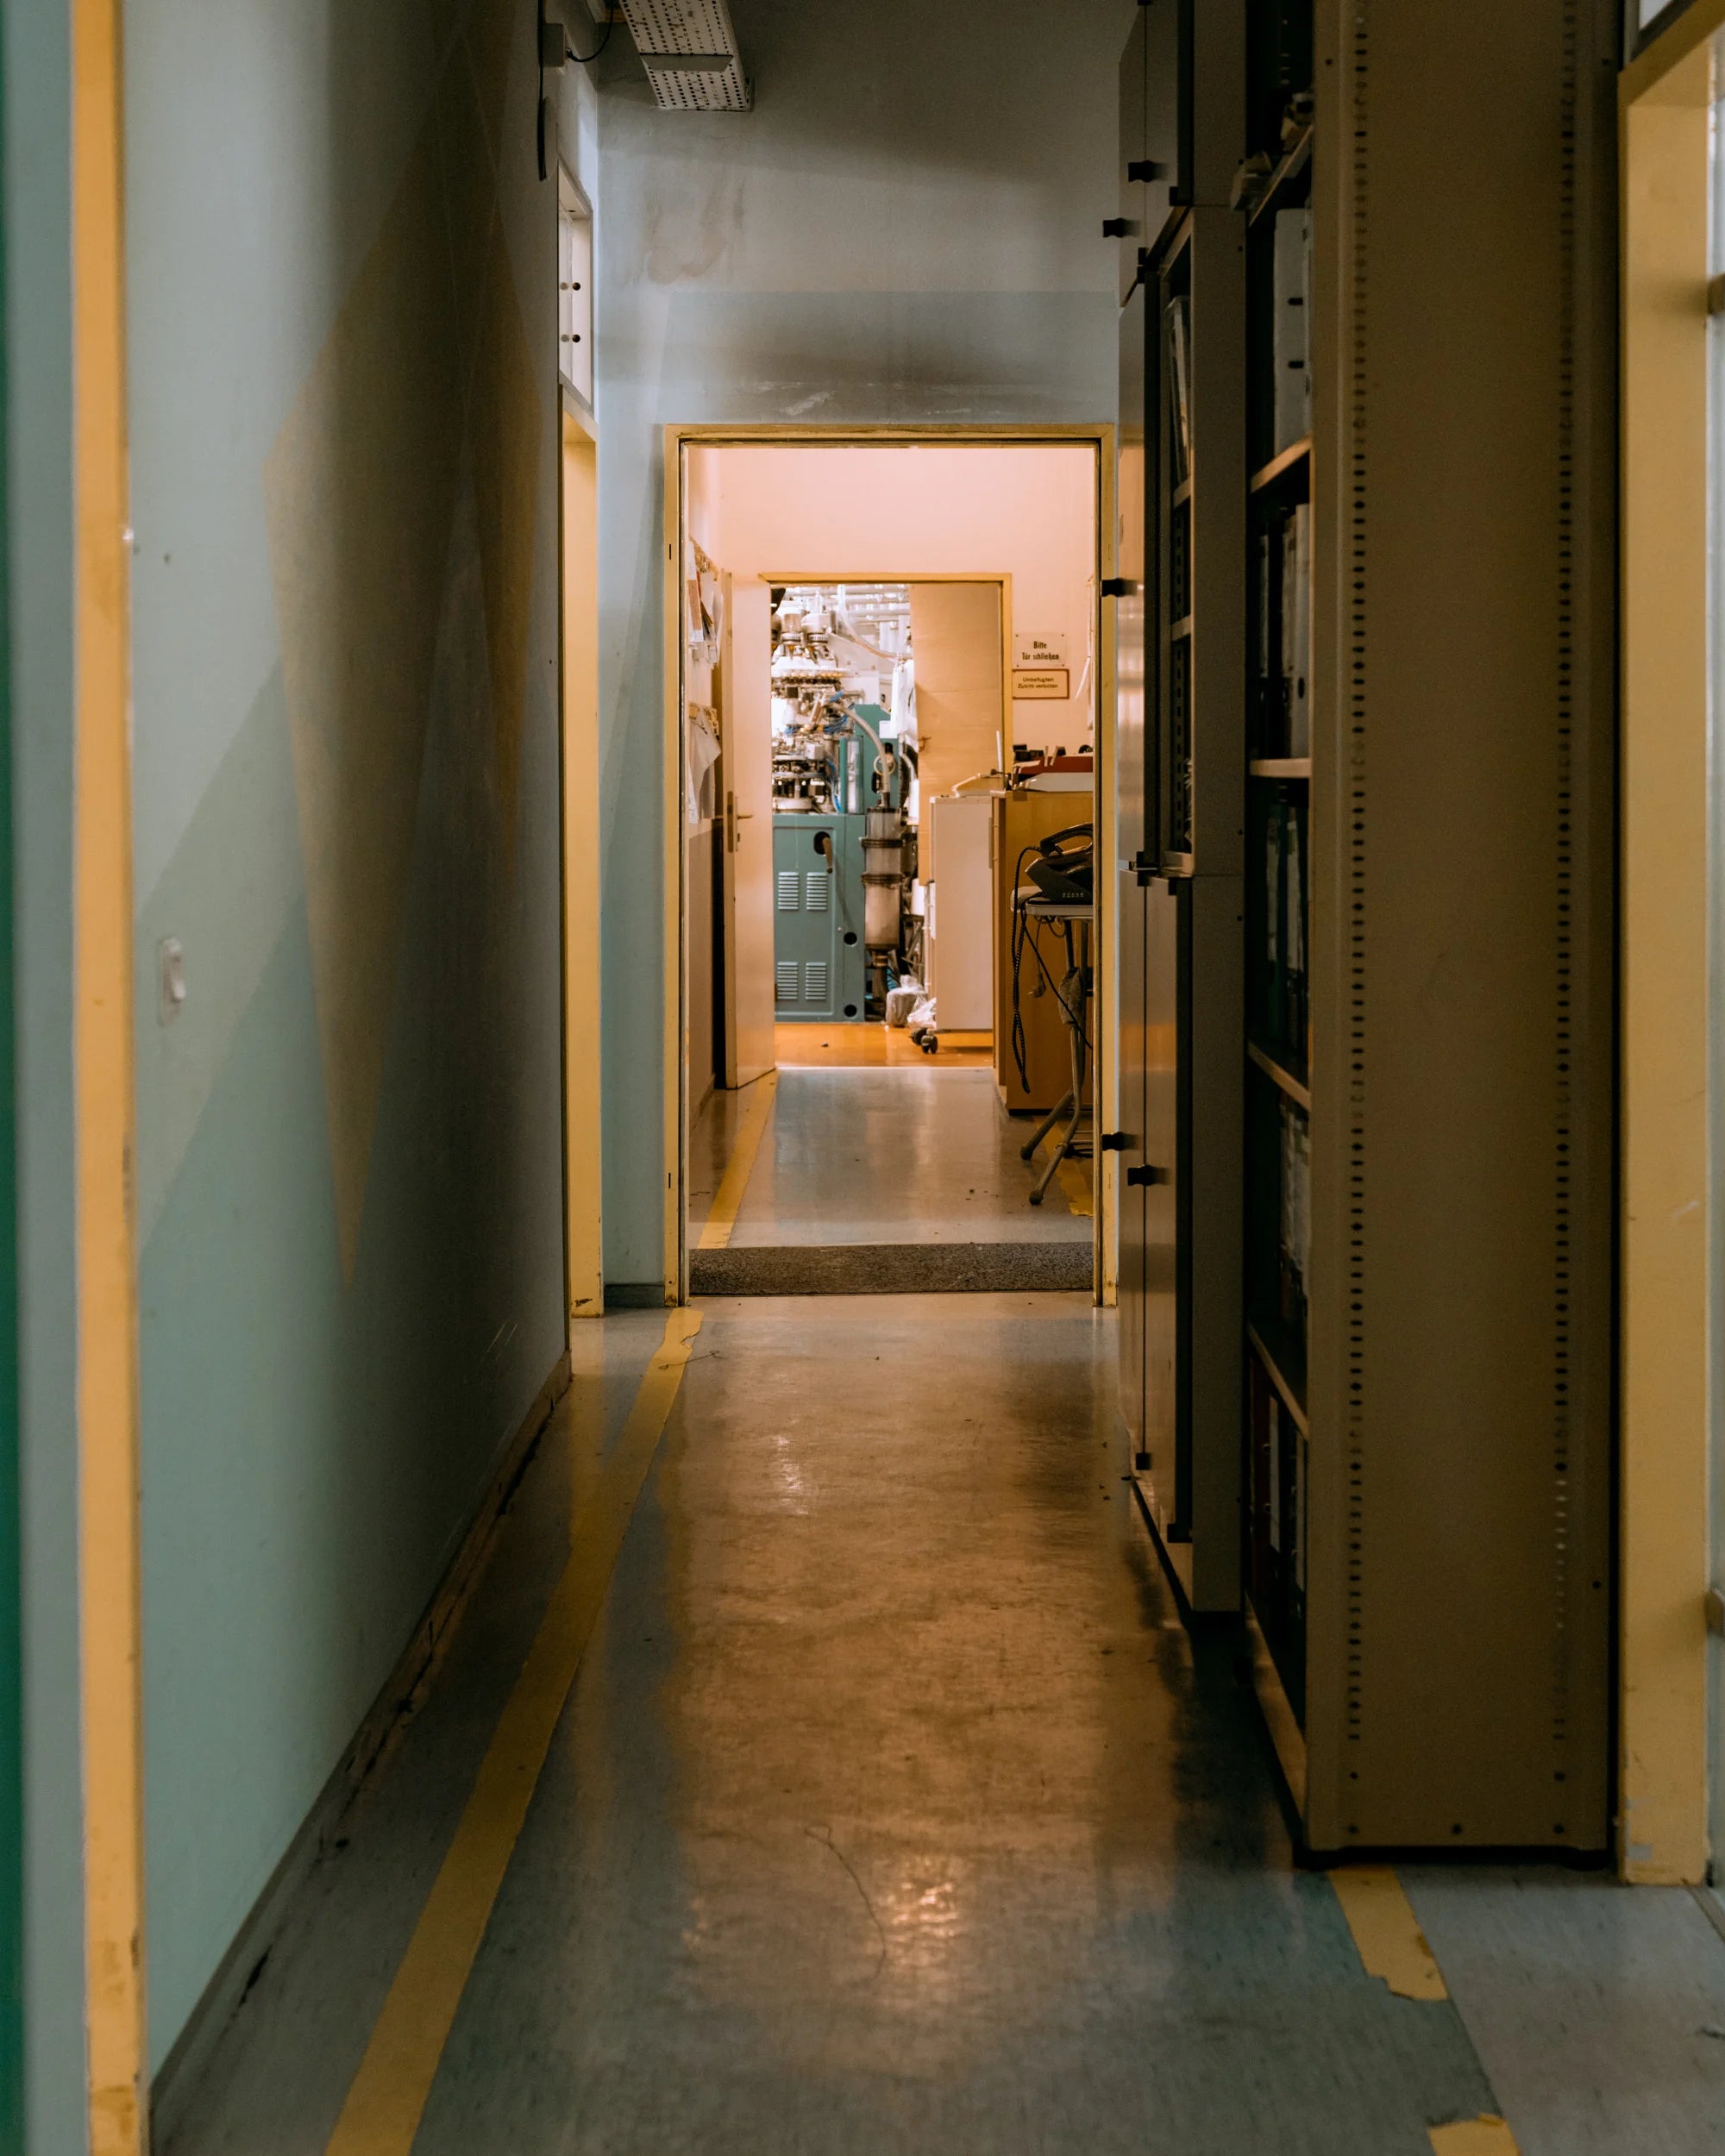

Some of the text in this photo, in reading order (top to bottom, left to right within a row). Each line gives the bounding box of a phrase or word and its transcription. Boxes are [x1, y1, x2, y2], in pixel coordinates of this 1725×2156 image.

[1033, 641, 1047, 649] Bitte
[1022, 652, 1060, 661] Tür schließen
